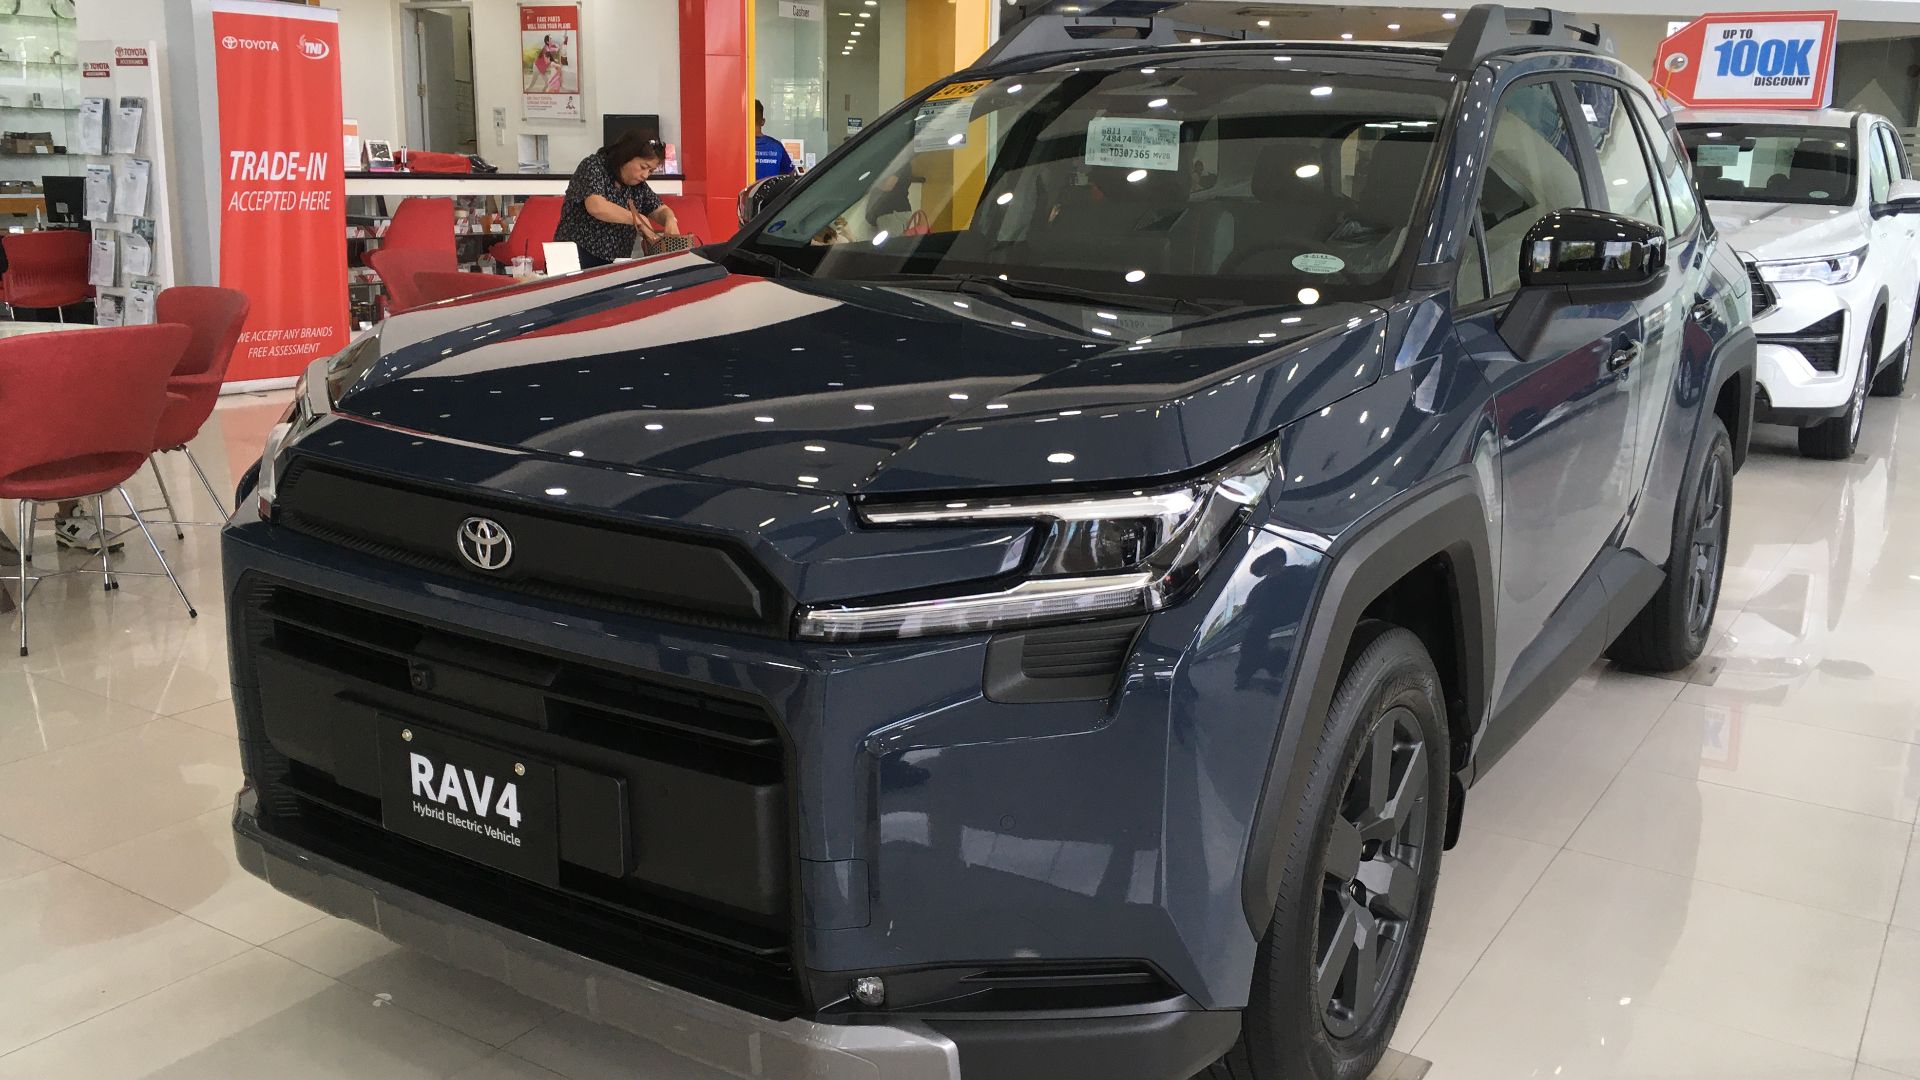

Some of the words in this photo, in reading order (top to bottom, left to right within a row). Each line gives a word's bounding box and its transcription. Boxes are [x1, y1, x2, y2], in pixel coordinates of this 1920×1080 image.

[792, 4, 810, 18] Cashier
[1722, 29, 1738, 40] UP
[1739, 28, 1754, 40] TO
[123, 48, 148, 57] TOYOTA
[239, 39, 280, 52] TOYOTA
[1713, 38, 1817, 77] 100K
[90, 62, 110, 70] TOYOTA
[1753, 76, 1811, 87] DISCOUNT
[229, 150, 328, 181] TRADE-IN
[227, 190, 297, 212] ACCEPTED
[298, 190, 332, 211] HERE
[250, 330, 283, 342] ACCEPT
[282, 328, 302, 340] ANY
[301, 326, 333, 339] BRANDS
[247, 346, 269, 359] FREE
[267, 342, 321, 357] ASSESSMENT
[409, 751, 522, 829] RAV4
[412, 800, 445, 822] Hybrid
[446, 812, 483, 834] Electric
[483, 823, 521, 847] Vehicle
